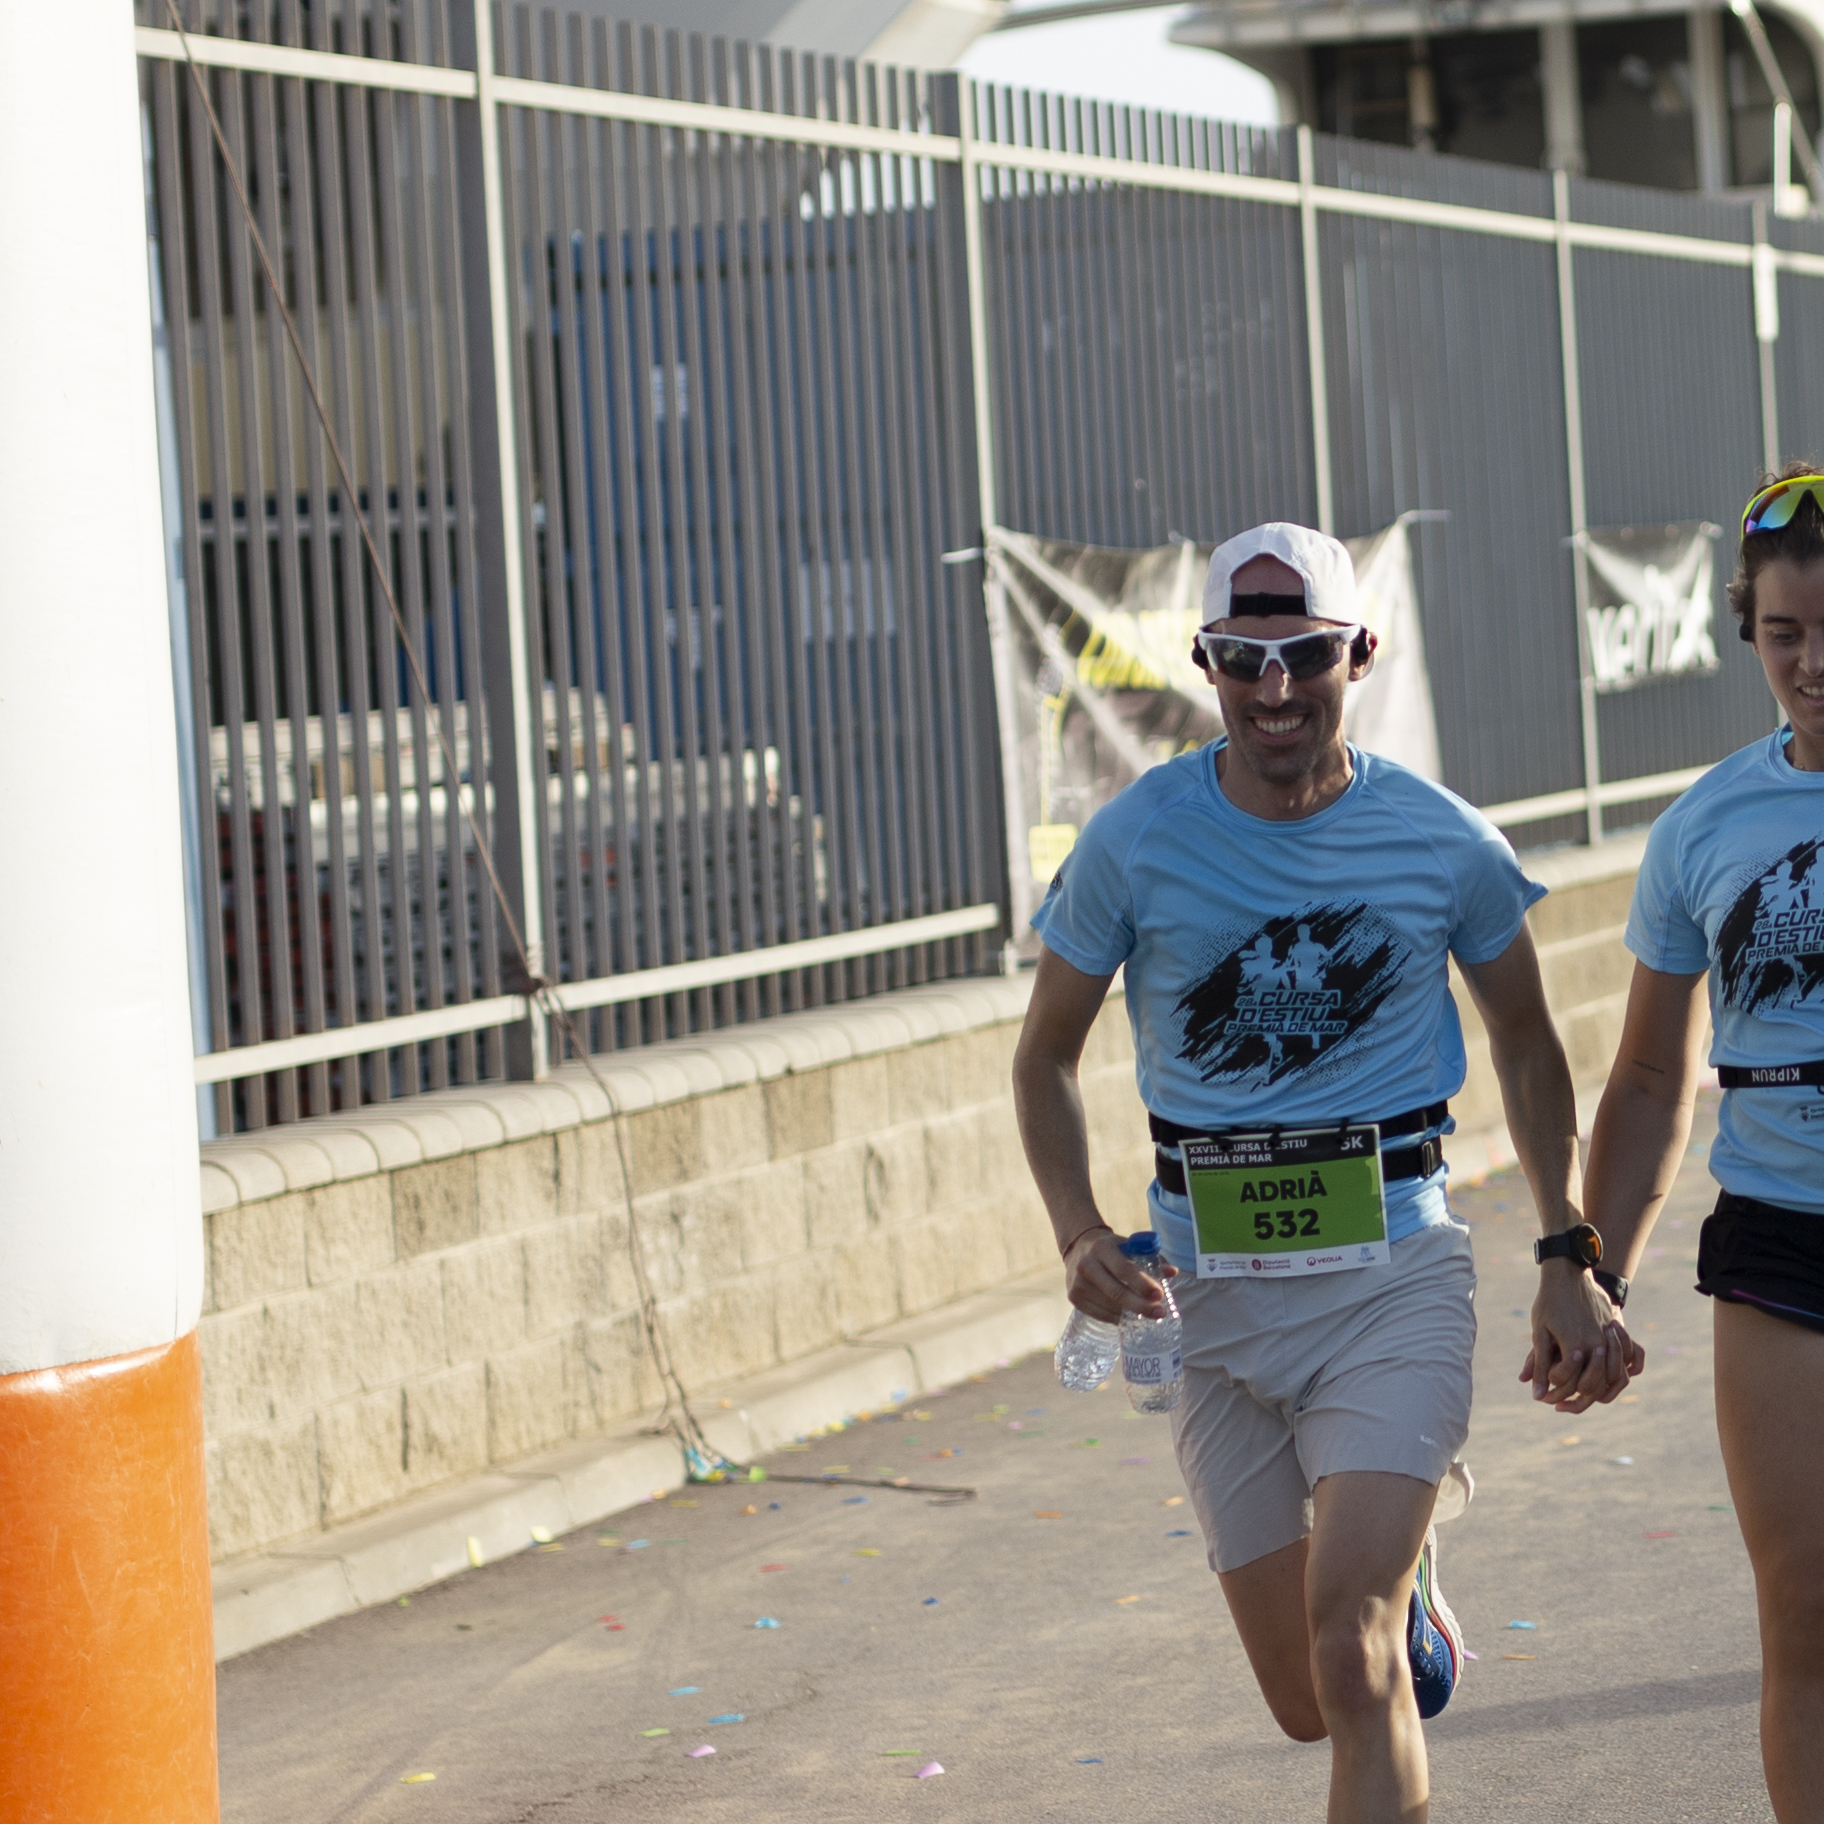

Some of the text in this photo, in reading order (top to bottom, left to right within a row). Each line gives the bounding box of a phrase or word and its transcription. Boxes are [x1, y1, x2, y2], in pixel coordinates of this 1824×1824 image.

[1802, 942, 1821, 953] DE
[1258, 991, 1339, 1007] CURSA
[1239, 1008, 1326, 1023] D'ESTIU
[1287, 1022, 1309, 1032] DE
[1310, 1022, 1345, 1032] MAR
[1752, 1067, 1800, 1083] KIPRUN
[1229, 1142, 1261, 1153] URSA
[1190, 1153, 1273, 1165] PREMIÀ DE MAR
[1240, 1170, 1328, 1203] ADRIÀ
[1253, 1208, 1321, 1240] 532
